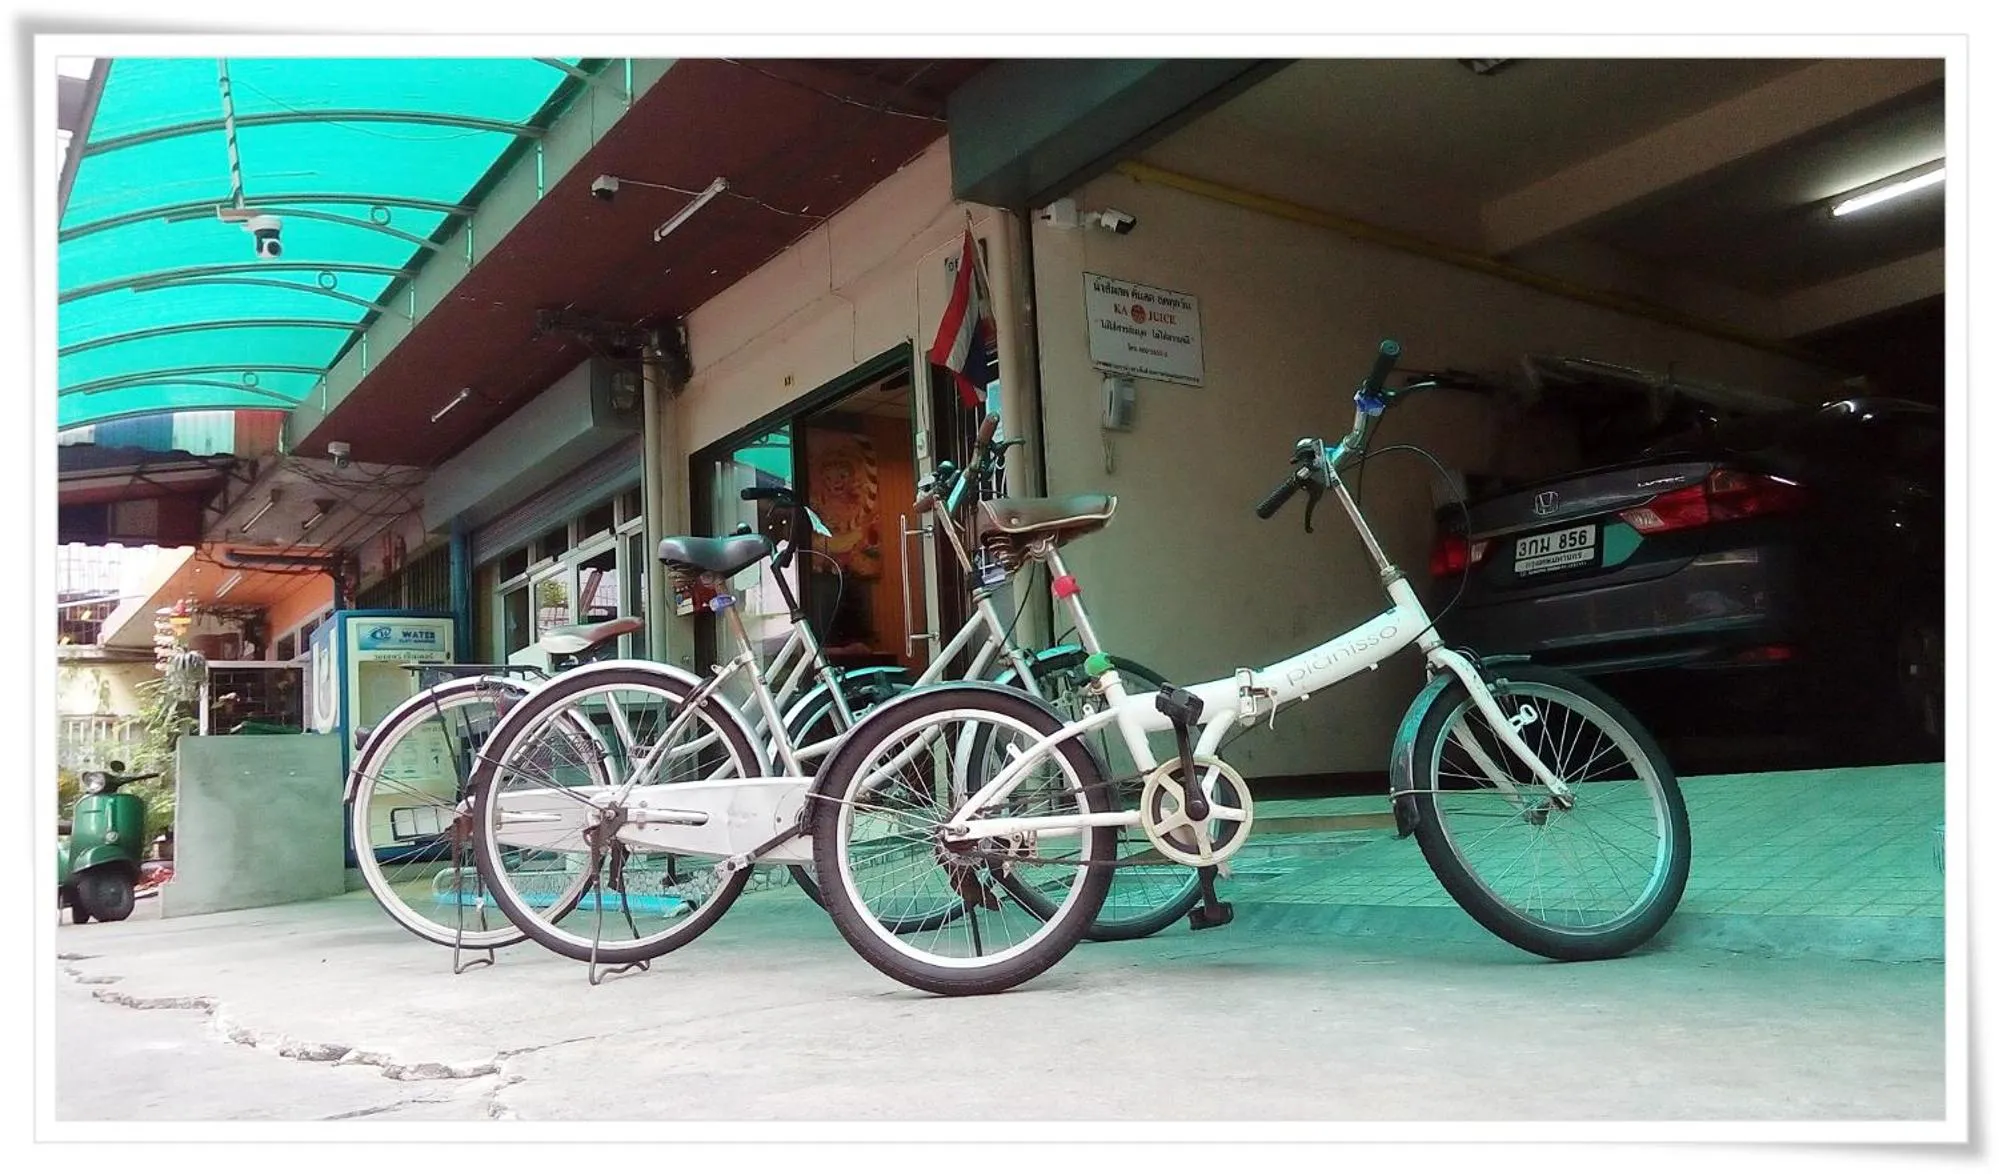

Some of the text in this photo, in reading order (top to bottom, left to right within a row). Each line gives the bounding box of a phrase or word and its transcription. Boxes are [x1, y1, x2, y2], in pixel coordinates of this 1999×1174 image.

[1113, 303, 1177, 325] KA JUICE
[1558, 530, 1587, 550] 856
[402, 630, 435, 639] WATER
[1285, 625, 1398, 687] pianisso
